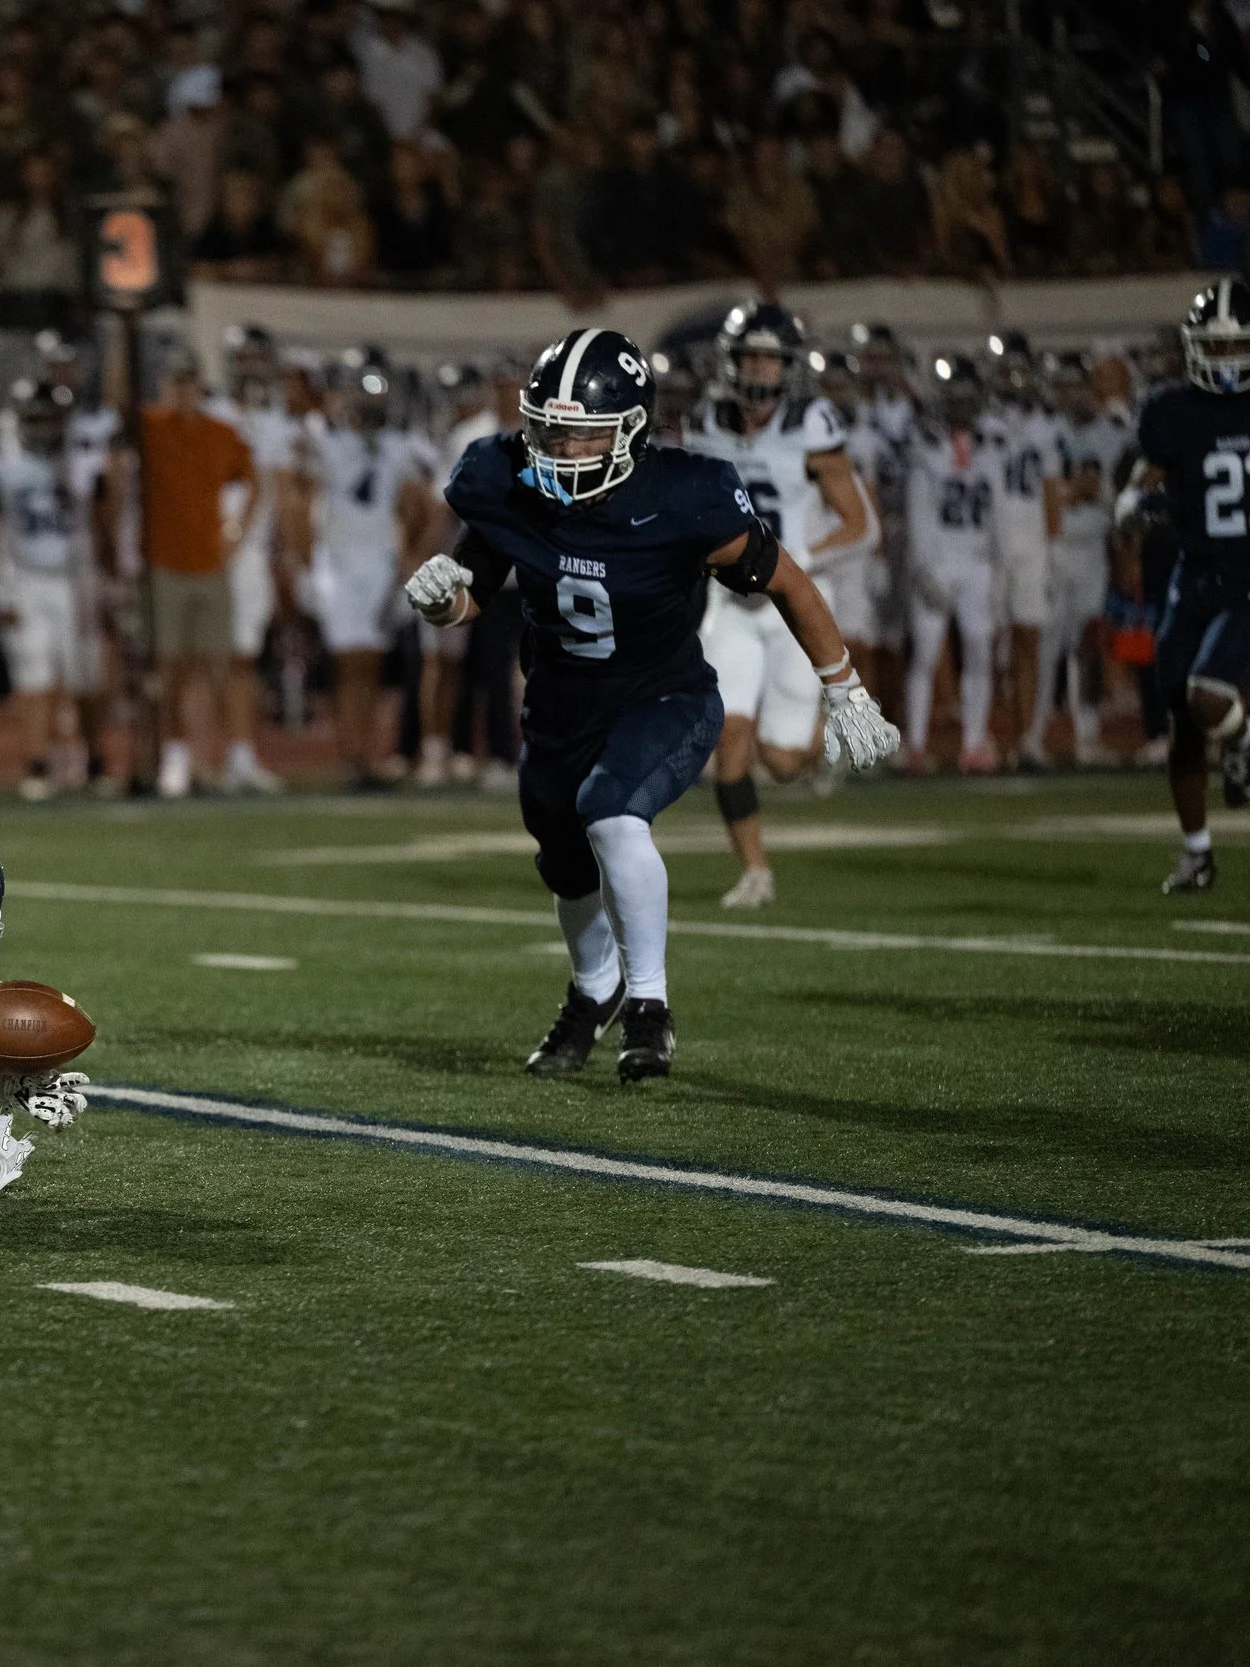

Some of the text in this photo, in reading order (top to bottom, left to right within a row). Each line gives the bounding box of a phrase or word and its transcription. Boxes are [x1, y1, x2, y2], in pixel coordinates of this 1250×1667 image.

[100, 211, 158, 289] 3
[617, 352, 647, 387] 9
[1203, 451, 1250, 537] 2
[558, 554, 607, 579] RANGERS
[556, 574, 616, 660] 9
